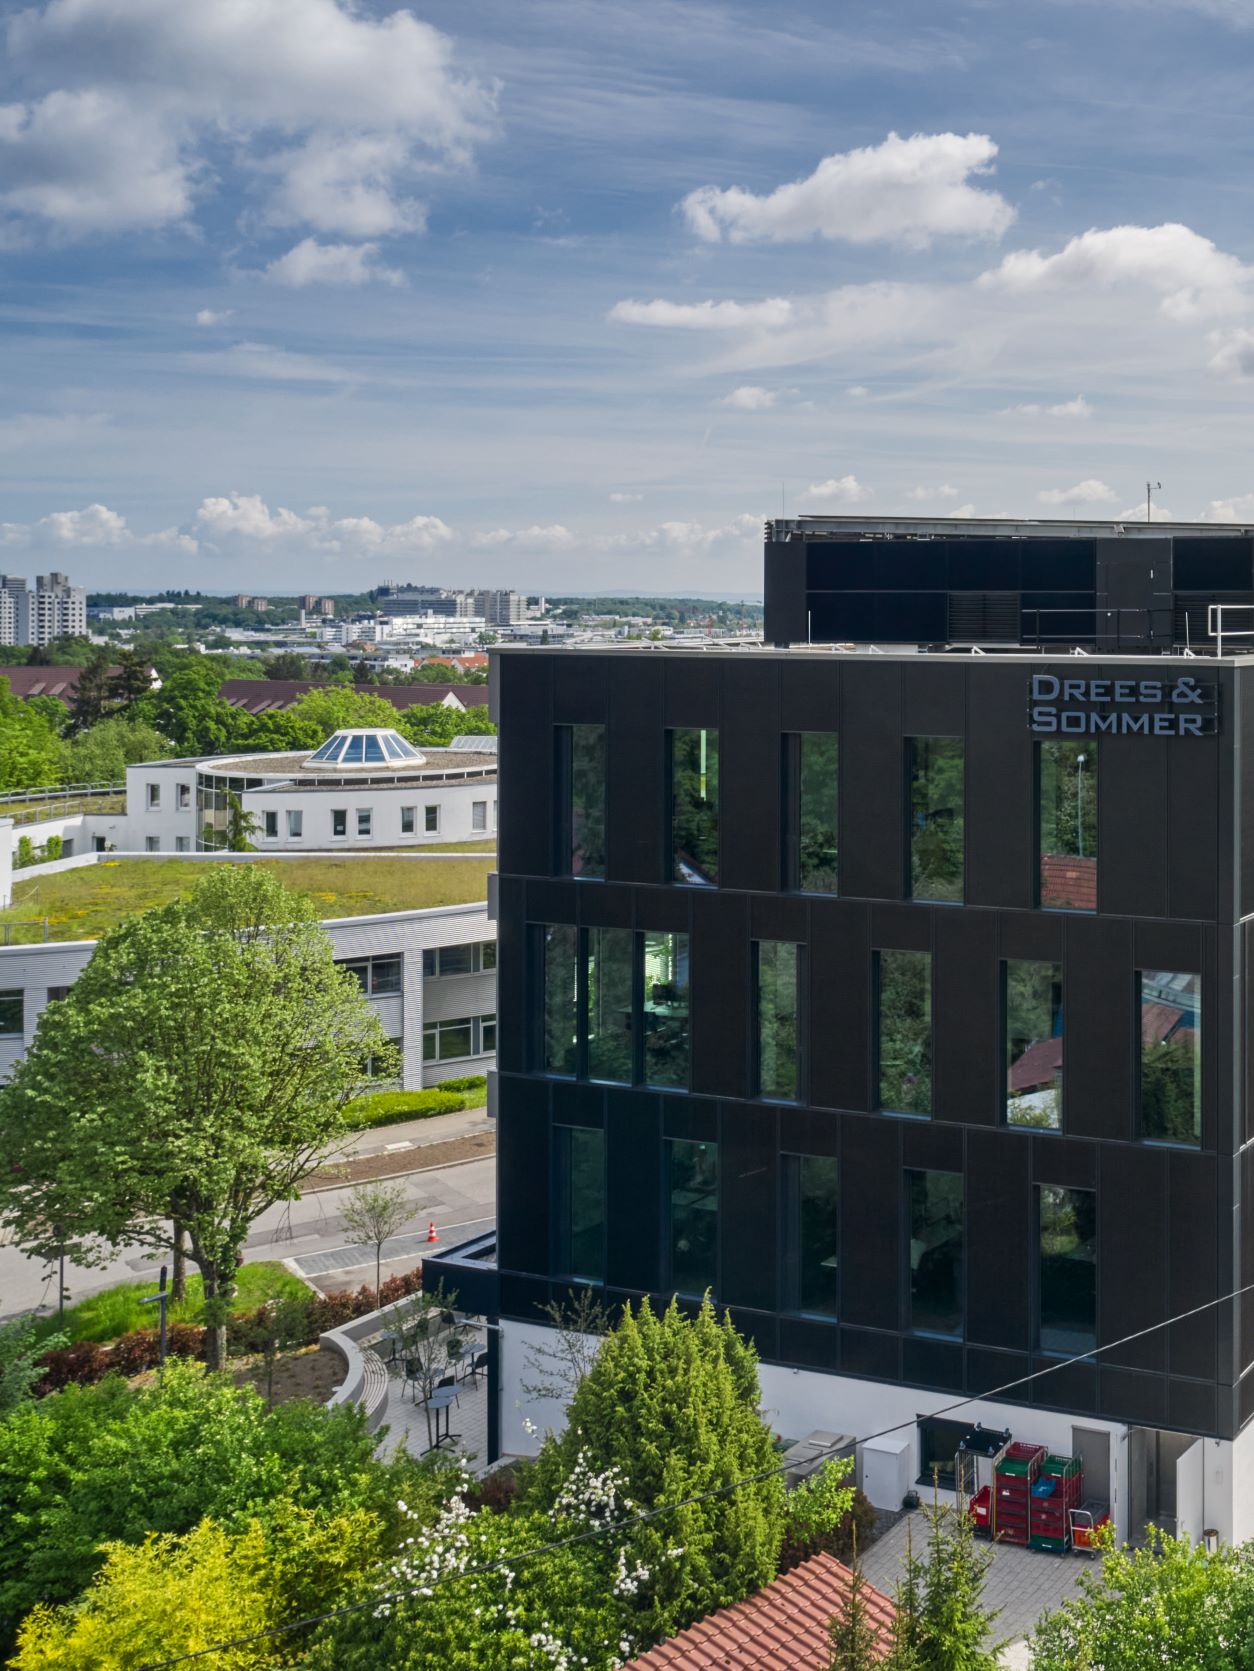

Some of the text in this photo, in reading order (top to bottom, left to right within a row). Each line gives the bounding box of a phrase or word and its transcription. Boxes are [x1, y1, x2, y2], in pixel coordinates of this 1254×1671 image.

[1032, 674, 1203, 704] DREES &
[1031, 706, 1203, 736] SOMMER
